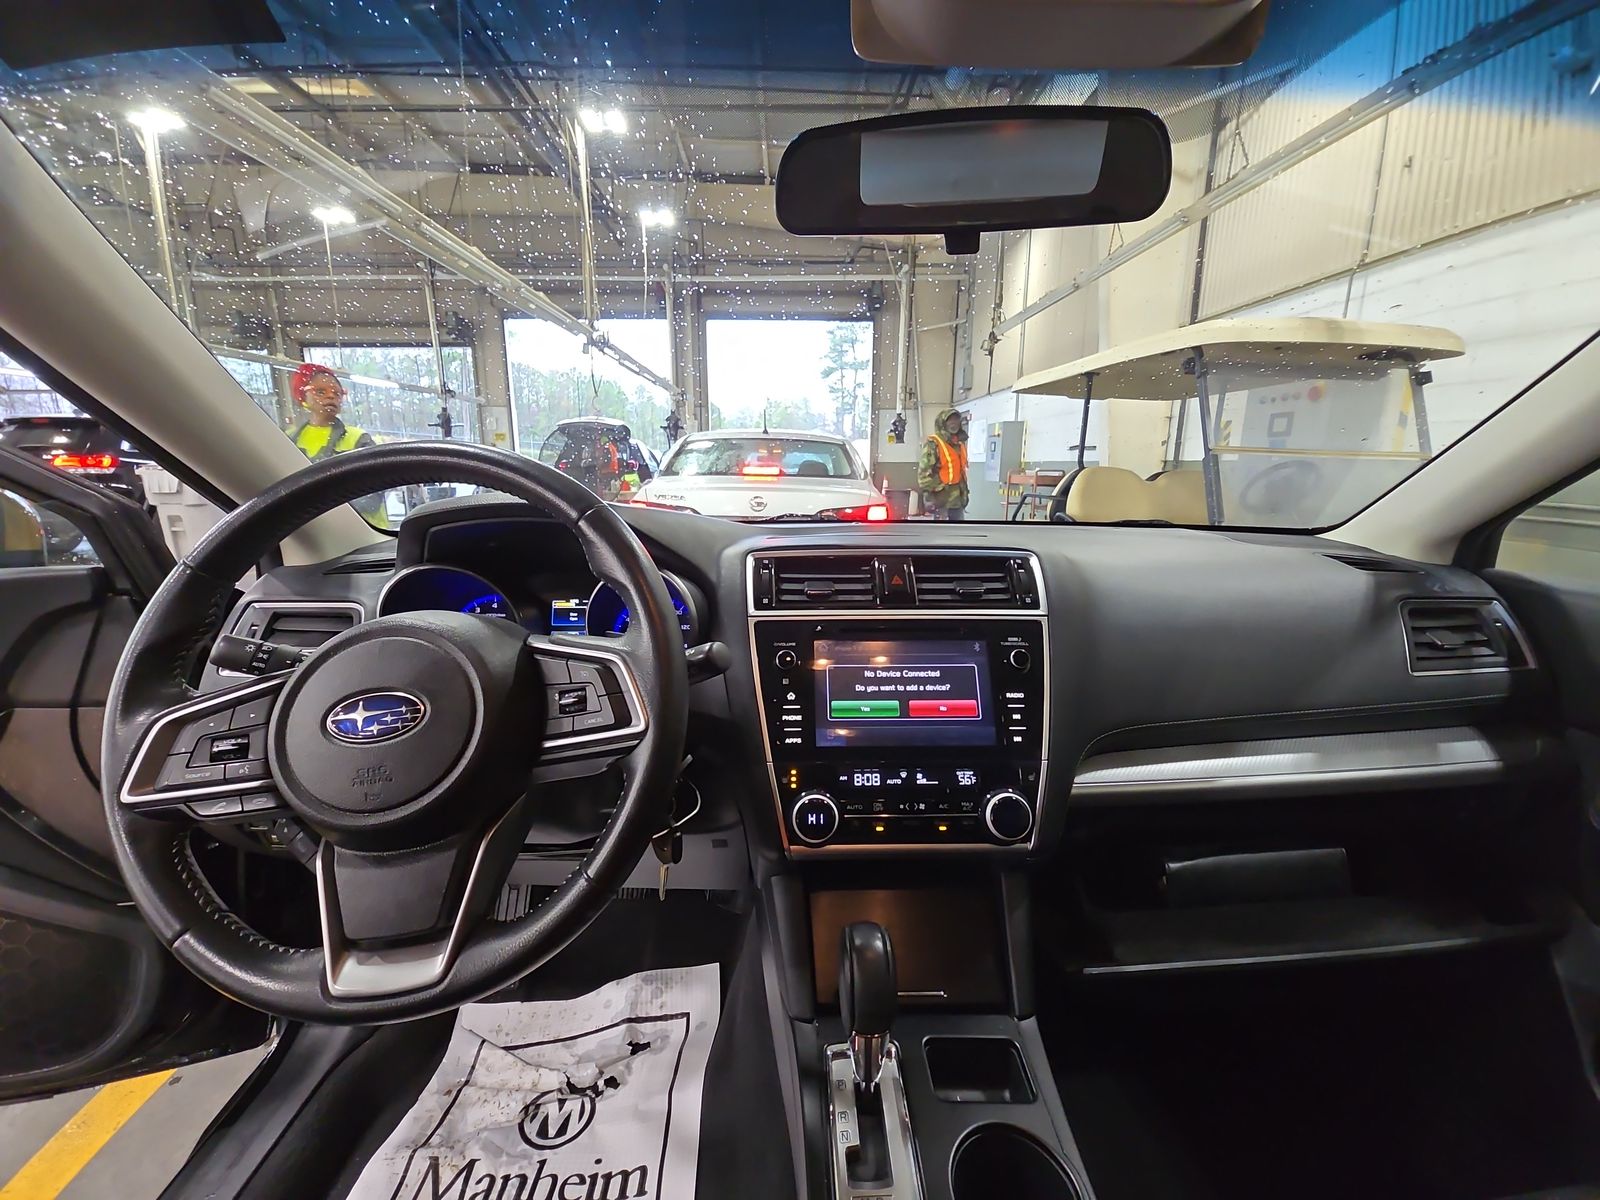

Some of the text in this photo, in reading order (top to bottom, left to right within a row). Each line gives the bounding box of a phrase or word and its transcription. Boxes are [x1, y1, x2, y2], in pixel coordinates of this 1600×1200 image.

[251, 661, 266, 669] AUTO
[864, 670, 941, 678] No Device Connected
[854, 773, 881, 786] 8:08
[412, 1155, 648, 1200] Manheim
